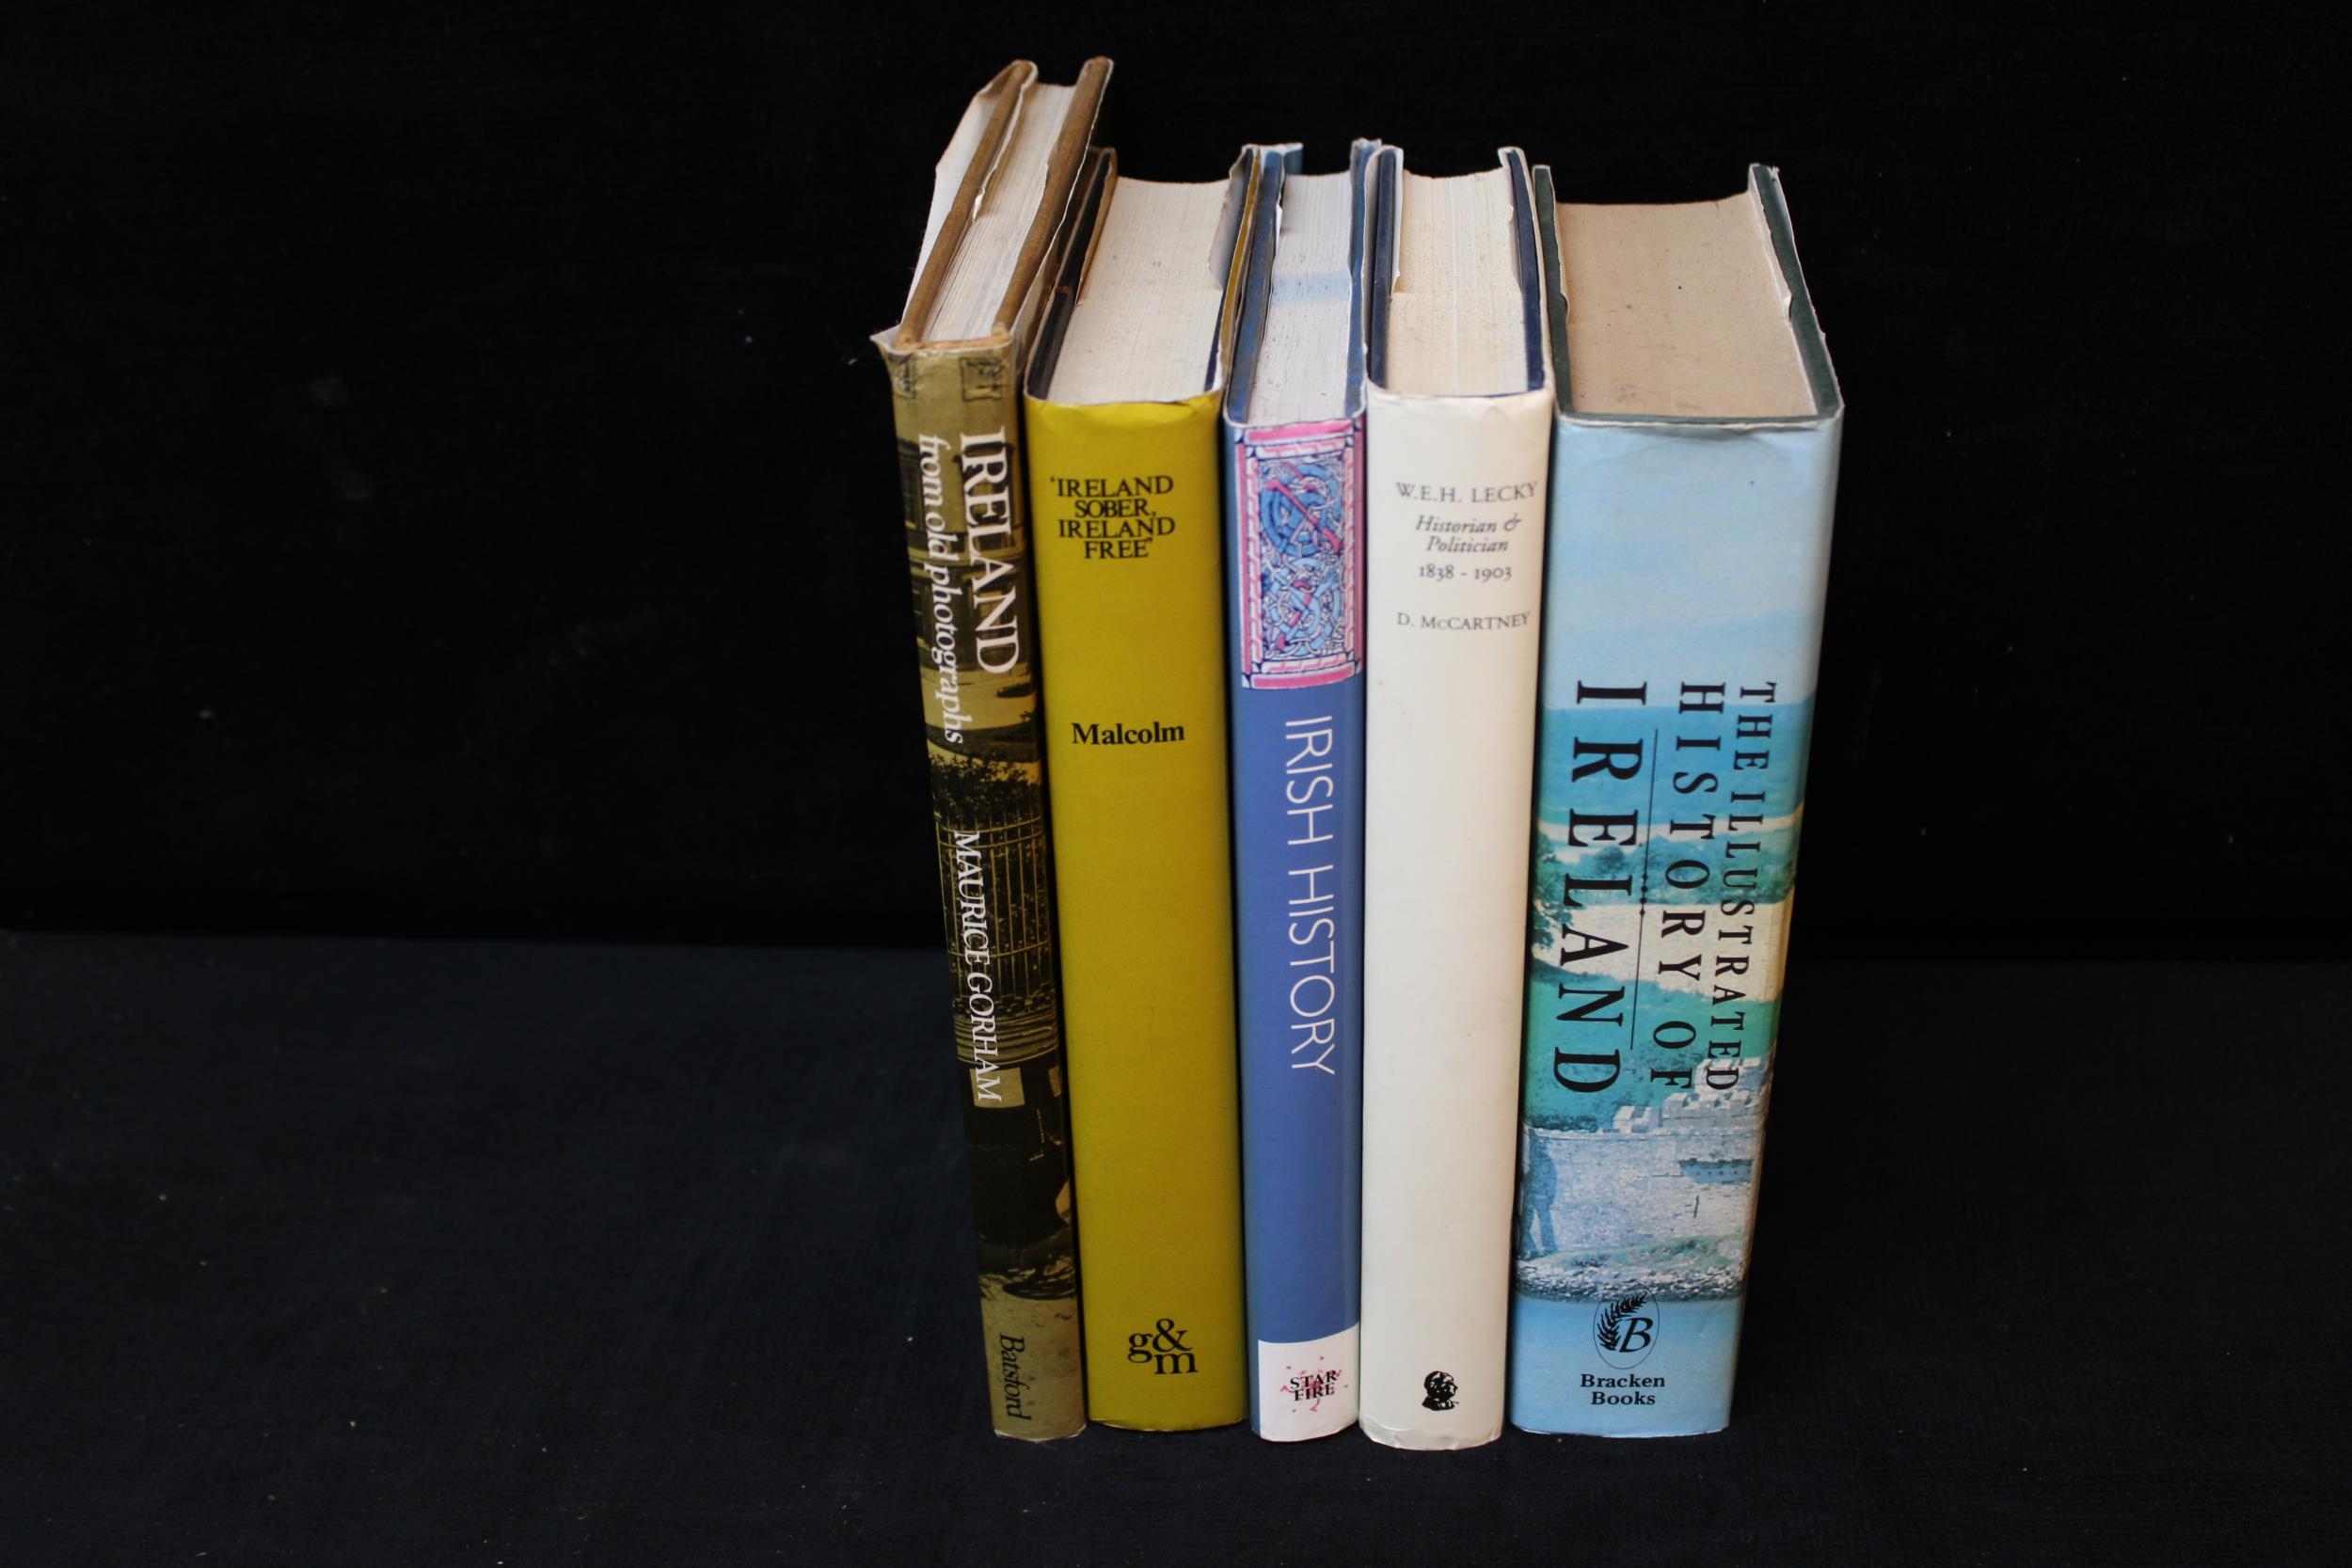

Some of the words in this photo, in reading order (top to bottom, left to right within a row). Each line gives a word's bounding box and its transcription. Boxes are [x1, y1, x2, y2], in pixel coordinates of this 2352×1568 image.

[918, 433, 952, 506] from
[1470, 481, 1538, 503] LECKY
[1058, 516, 1176, 539] IRELAND
[1073, 498, 1156, 518] SOBER,
[1414, 514, 1498, 533] Historian
[1502, 513, 1523, 532] &
[924, 512, 960, 562] old
[961, 425, 1020, 674] IRELAND
[1425, 534, 1509, 553] Politician
[1418, 563, 1455, 582] 1838
[1473, 566, 1513, 583] 1903
[1396, 611, 1415, 627] D.
[924, 561, 973, 745] photographs
[1071, 721, 1185, 745] Malcolm
[1733, 681, 1778, 771] THE
[1285, 716, 1335, 846] IRISH
[1657, 681, 1726, 982] HISTORY
[954, 829, 990, 965] MAURICE
[1552, 679, 1647, 1094] IRELAND
[1705, 790, 1766, 1092] ILLUSTRATED
[1288, 864, 1336, 1075] HISTORY
[967, 972, 1003, 1102] GORHAM
[1649, 1020, 1697, 1089] OF
[1618, 1317, 1654, 1353] B
[999, 1332, 1033, 1421] Batsford
[1289, 1370, 1338, 1389] STAR
[1294, 1382, 1336, 1402] FIRE
[1581, 1373, 1665, 1387] Bracken
[1591, 1391, 1656, 1405] Books
